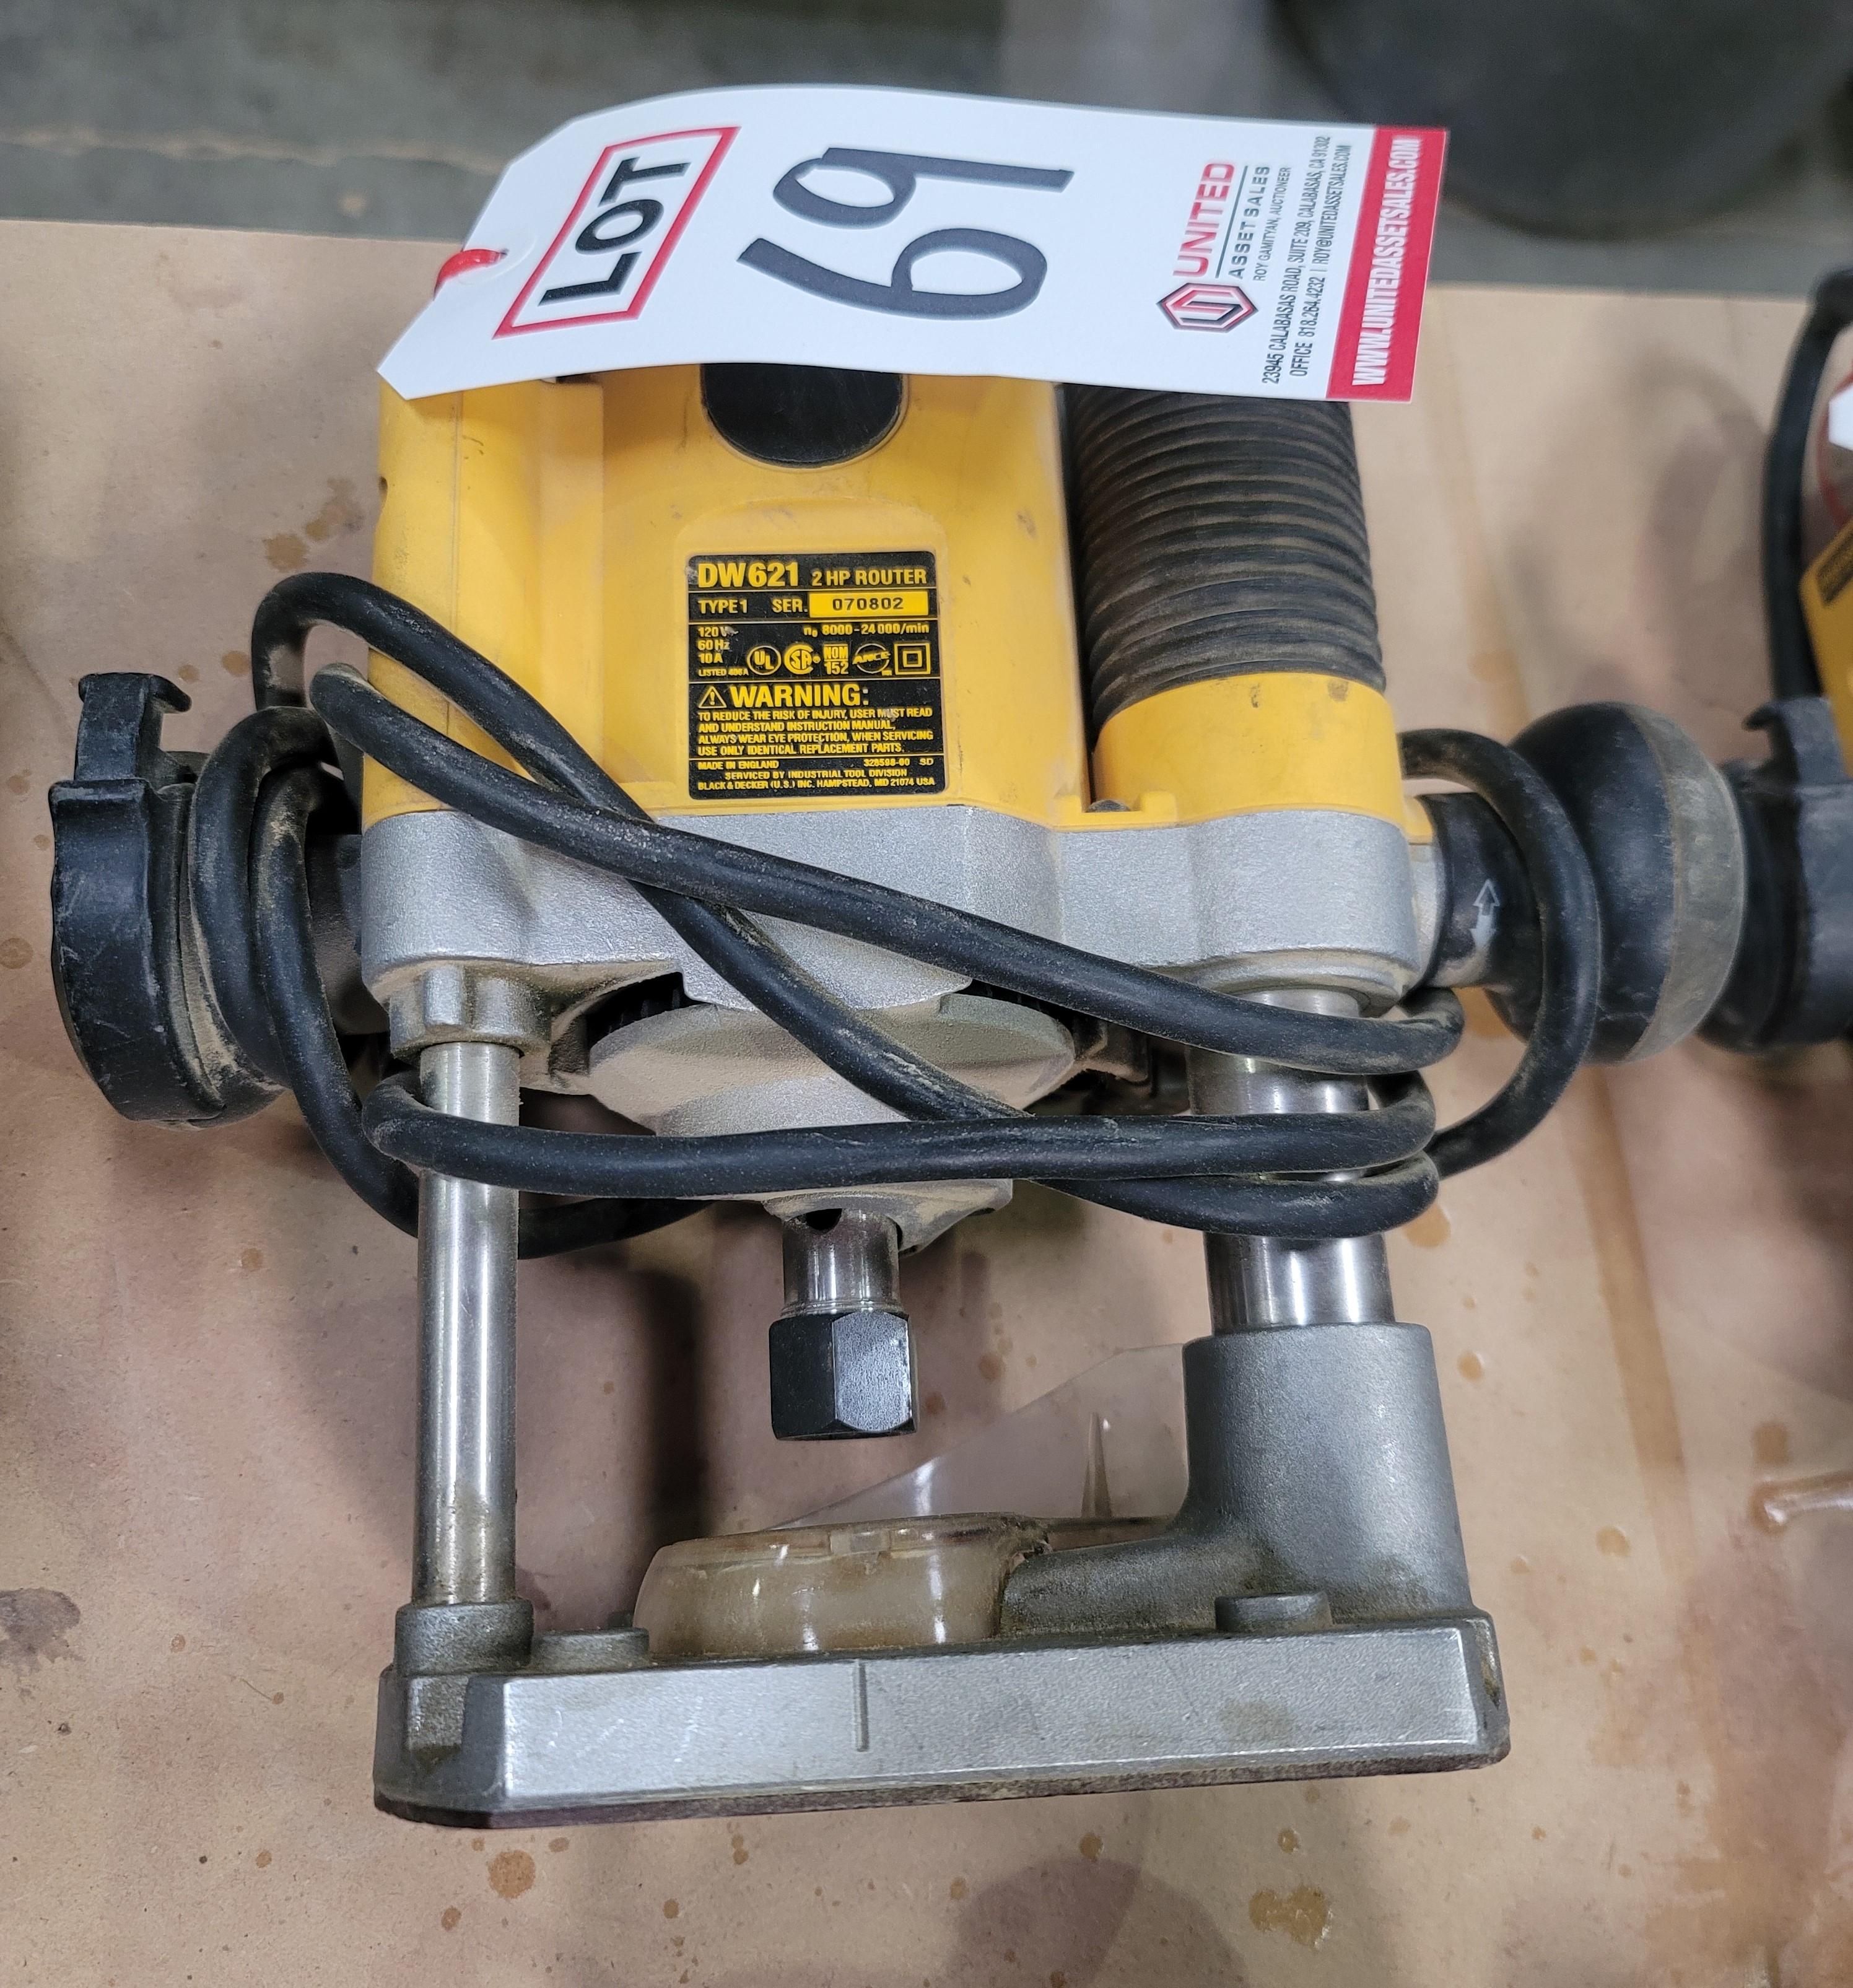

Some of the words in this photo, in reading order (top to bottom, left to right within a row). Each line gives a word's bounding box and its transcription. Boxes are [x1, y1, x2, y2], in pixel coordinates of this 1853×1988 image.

[1312, 136, 1330, 157] 91302
[1308, 159, 1326, 169] CA
[1269, 167, 1291, 216] AUCTIONEER
[1297, 171, 1327, 218] CALABASAS,
[1312, 145, 1352, 264] ROY@UNITEDASSETSALES.COM
[538, 157, 691, 306] LOT
[1173, 163, 1234, 277] UNITED
[1228, 222, 1256, 279] ASSET
[1244, 166, 1270, 217] SALES
[1294, 220, 1315, 238] 209,
[737, 147, 1075, 321] 69
[1258, 217, 1282, 261] GAMITYAN,
[1287, 238, 1308, 263] SUITE
[1352, 137, 1423, 385] WWW.UNITEDASSETSALES.COM
[1253, 263, 1269, 281] ROY
[1281, 266, 1306, 292] ROAD,
[1297, 277, 1325, 338] 818.264.4232
[1268, 294, 1296, 351] CALABASAS
[1262, 353, 1284, 384] 23945
[1289, 342, 1312, 377] OFFICE
[826, 570, 851, 586] HP
[855, 569, 927, 585] ROUTER
[772, 598, 808, 613] SER.
[832, 597, 904, 611] 070802
[824, 646, 848, 660] NOM
[698, 668, 727, 677] LISTED
[824, 661, 849, 675] 152
[729, 683, 869, 708] WARNING:
[698, 712, 711, 722] TO
[712, 712, 751, 722] REDUCE
[752, 711, 771, 720] THE
[772, 710, 795, 720] RISK
[797, 710, 811, 720] OF
[811, 709, 848, 720] INJURY,
[849, 708, 876, 719] USER
[877, 708, 905, 719] MUST
[906, 707, 933, 717] READ
[698, 723, 720, 733] AND
[721, 722, 785, 732] UNDERSTAND
[787, 720, 850, 731] INSTRUCTION
[852, 720, 896, 731] MANUAL,
[698, 735, 736, 744] ALWAYS
[738, 734, 767, 744] WEAR
[768, 733, 786, 743] EYE
[787, 732, 850, 743] PROTECTION,
[852, 731, 881, 742] WHEN
[883, 730, 934, 741] SERVICING
[698, 746, 718, 756] USE
[720, 746, 744, 756] ONLY
[747, 744, 796, 755] IDENTICAL
[800, 743, 869, 754] REPLACEMENT
[871, 742, 904, 753] PARTS.
[698, 761, 724, 770] MADE
[726, 761, 736, 770] IN
[738, 761, 779, 770] ENGLAND
[725, 771, 770, 780] SERVICED
[772, 771, 785, 780] BY
[788, 769, 843, 779] INDUSTRIAL
[845, 769, 867, 778] TOOL
[868, 768, 907, 777] DIVISION
[874, 778, 889, 787] MD
[890, 777, 915, 787] 21074
[916, 777, 936, 786] USA
